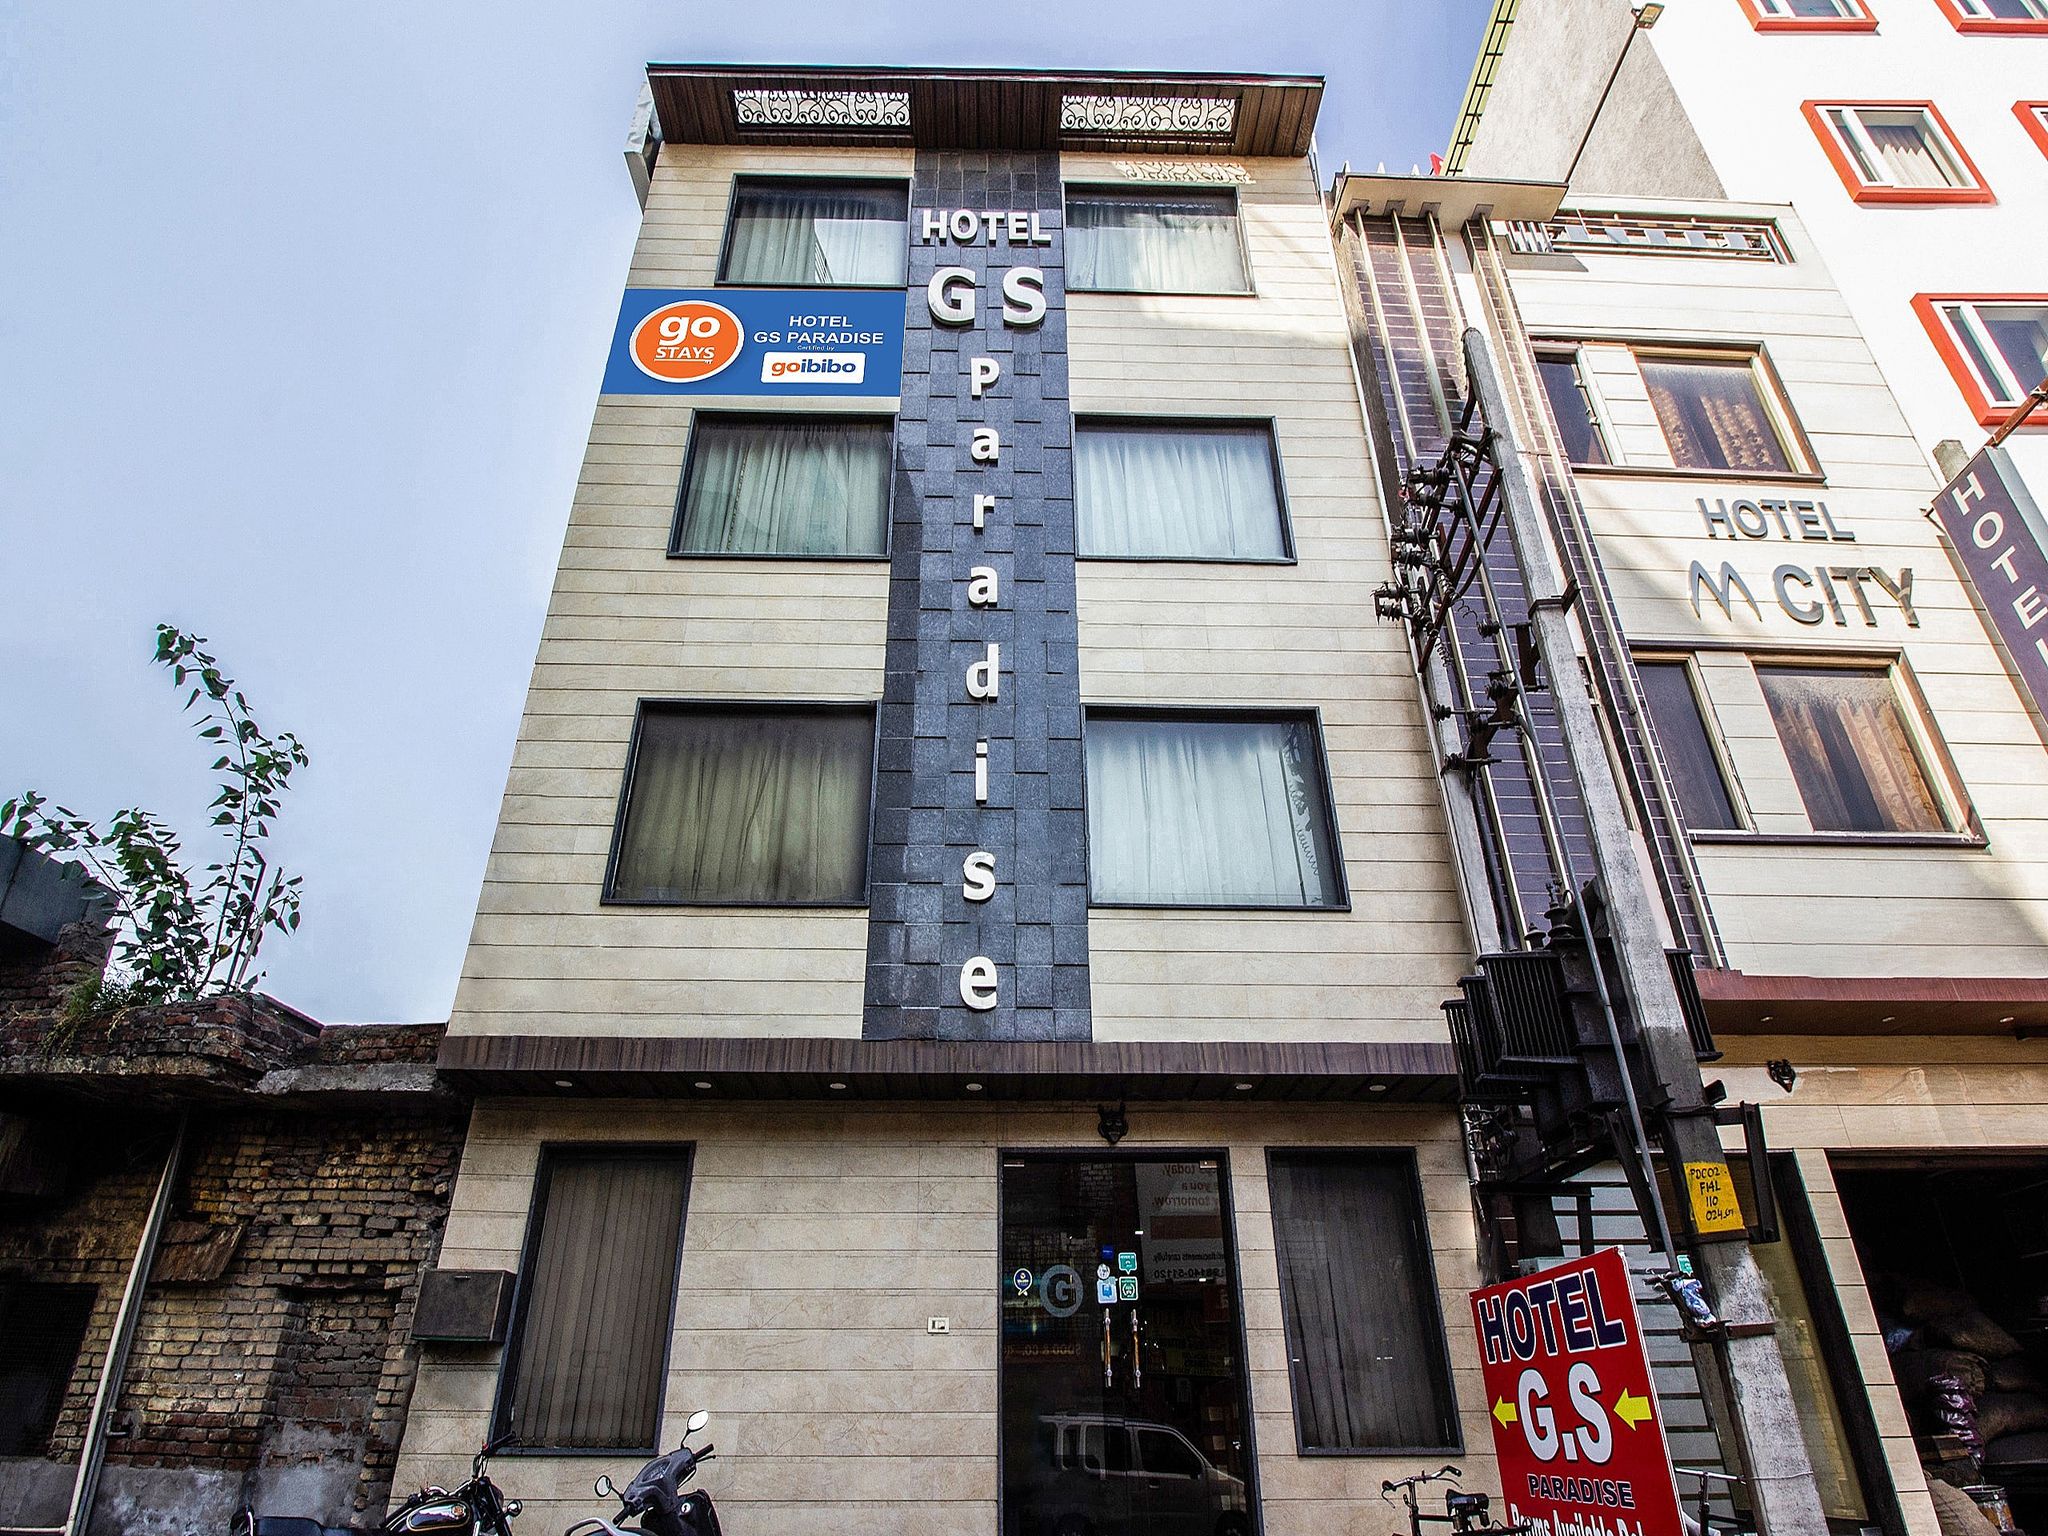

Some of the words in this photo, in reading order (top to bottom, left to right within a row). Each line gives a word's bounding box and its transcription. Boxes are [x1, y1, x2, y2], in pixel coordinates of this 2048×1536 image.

[922, 209, 1052, 246] HOTEL
[926, 266, 1048, 329] GS
[659, 315, 721, 346] go
[753, 331, 781, 344] GS
[787, 331, 884, 344] PARADISE
[789, 315, 853, 327] HOTEL
[655, 346, 715, 359] STAYS
[771, 359, 856, 376] goibibo
[1696, 497, 1856, 542] HOTEL
[1687, 559, 1763, 623] M
[1772, 563, 1921, 629] CITY
[1477, 1268, 1627, 1366] HOTEL
[1517, 1363, 1614, 1464] G.S
[1527, 1473, 1636, 1510] PARADISE
